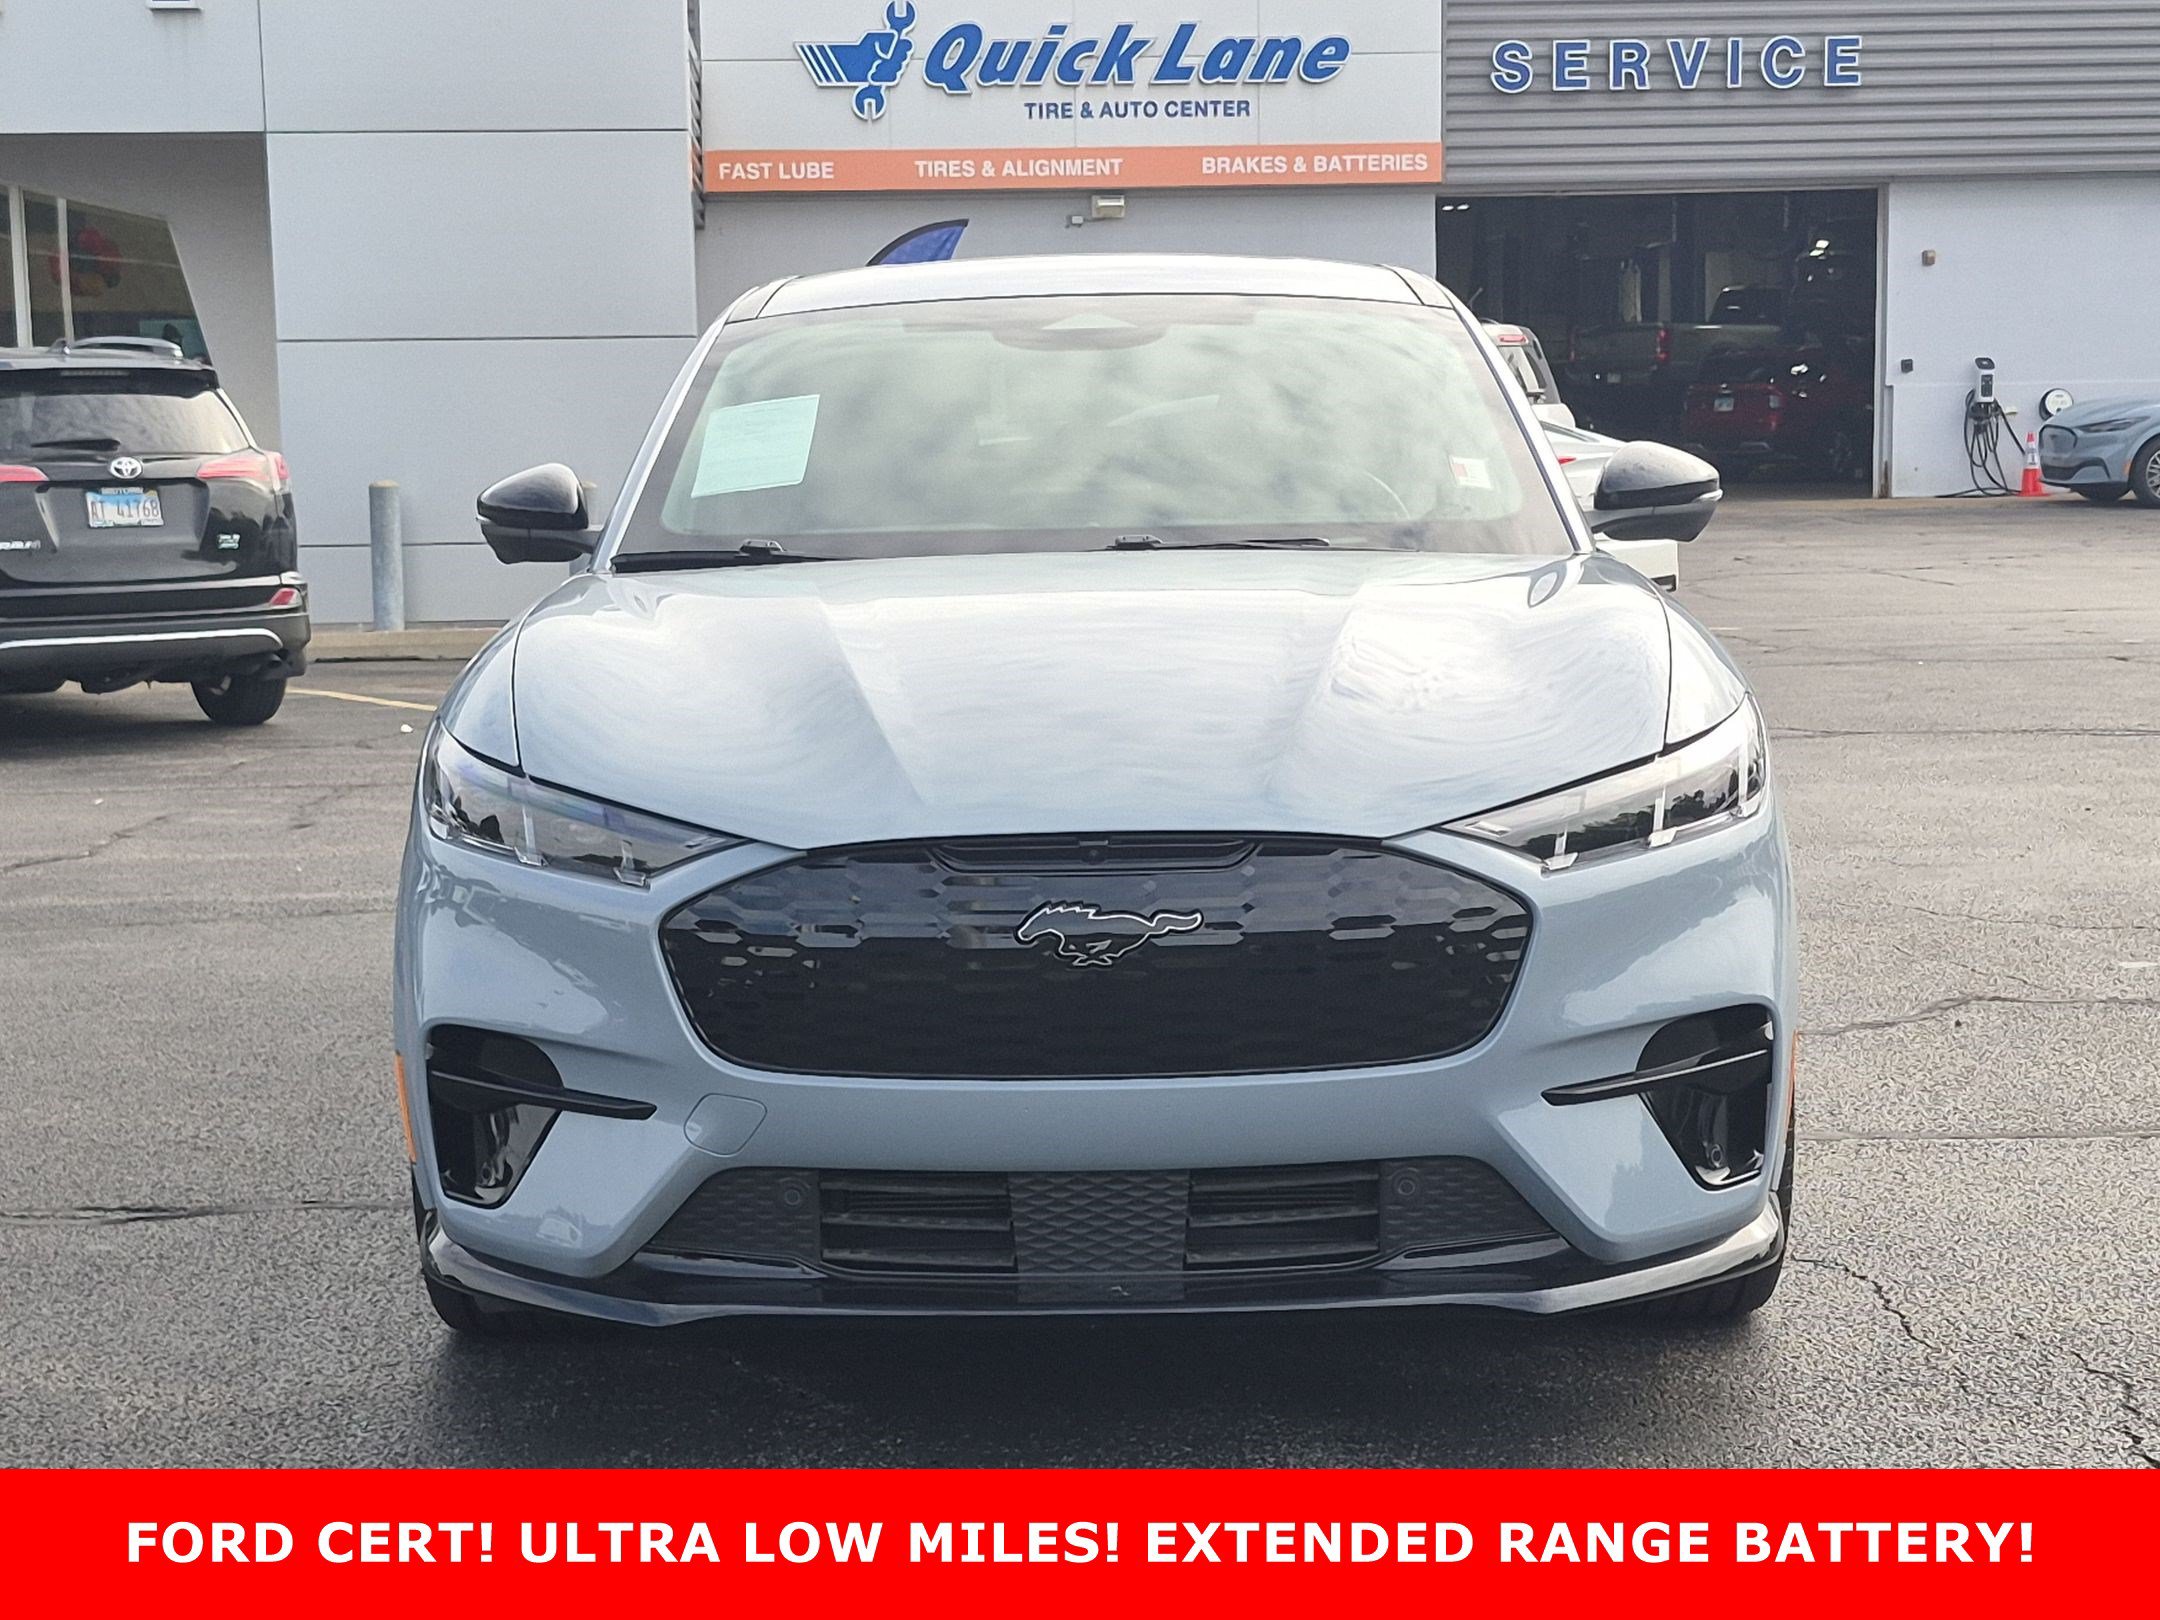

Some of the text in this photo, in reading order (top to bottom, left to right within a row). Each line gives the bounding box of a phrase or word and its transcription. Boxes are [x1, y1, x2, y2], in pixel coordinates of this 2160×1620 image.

[923, 21, 1352, 94] Quick Lane
[1491, 35, 1862, 93] SERVICE
[1024, 100, 1251, 120] TIRE & AUTO CENTER
[719, 161, 834, 180] FAST LUBE
[914, 157, 1124, 178] TIRES & ALIGNMENT
[1202, 153, 1429, 174] BRAKES & BATTERIES
